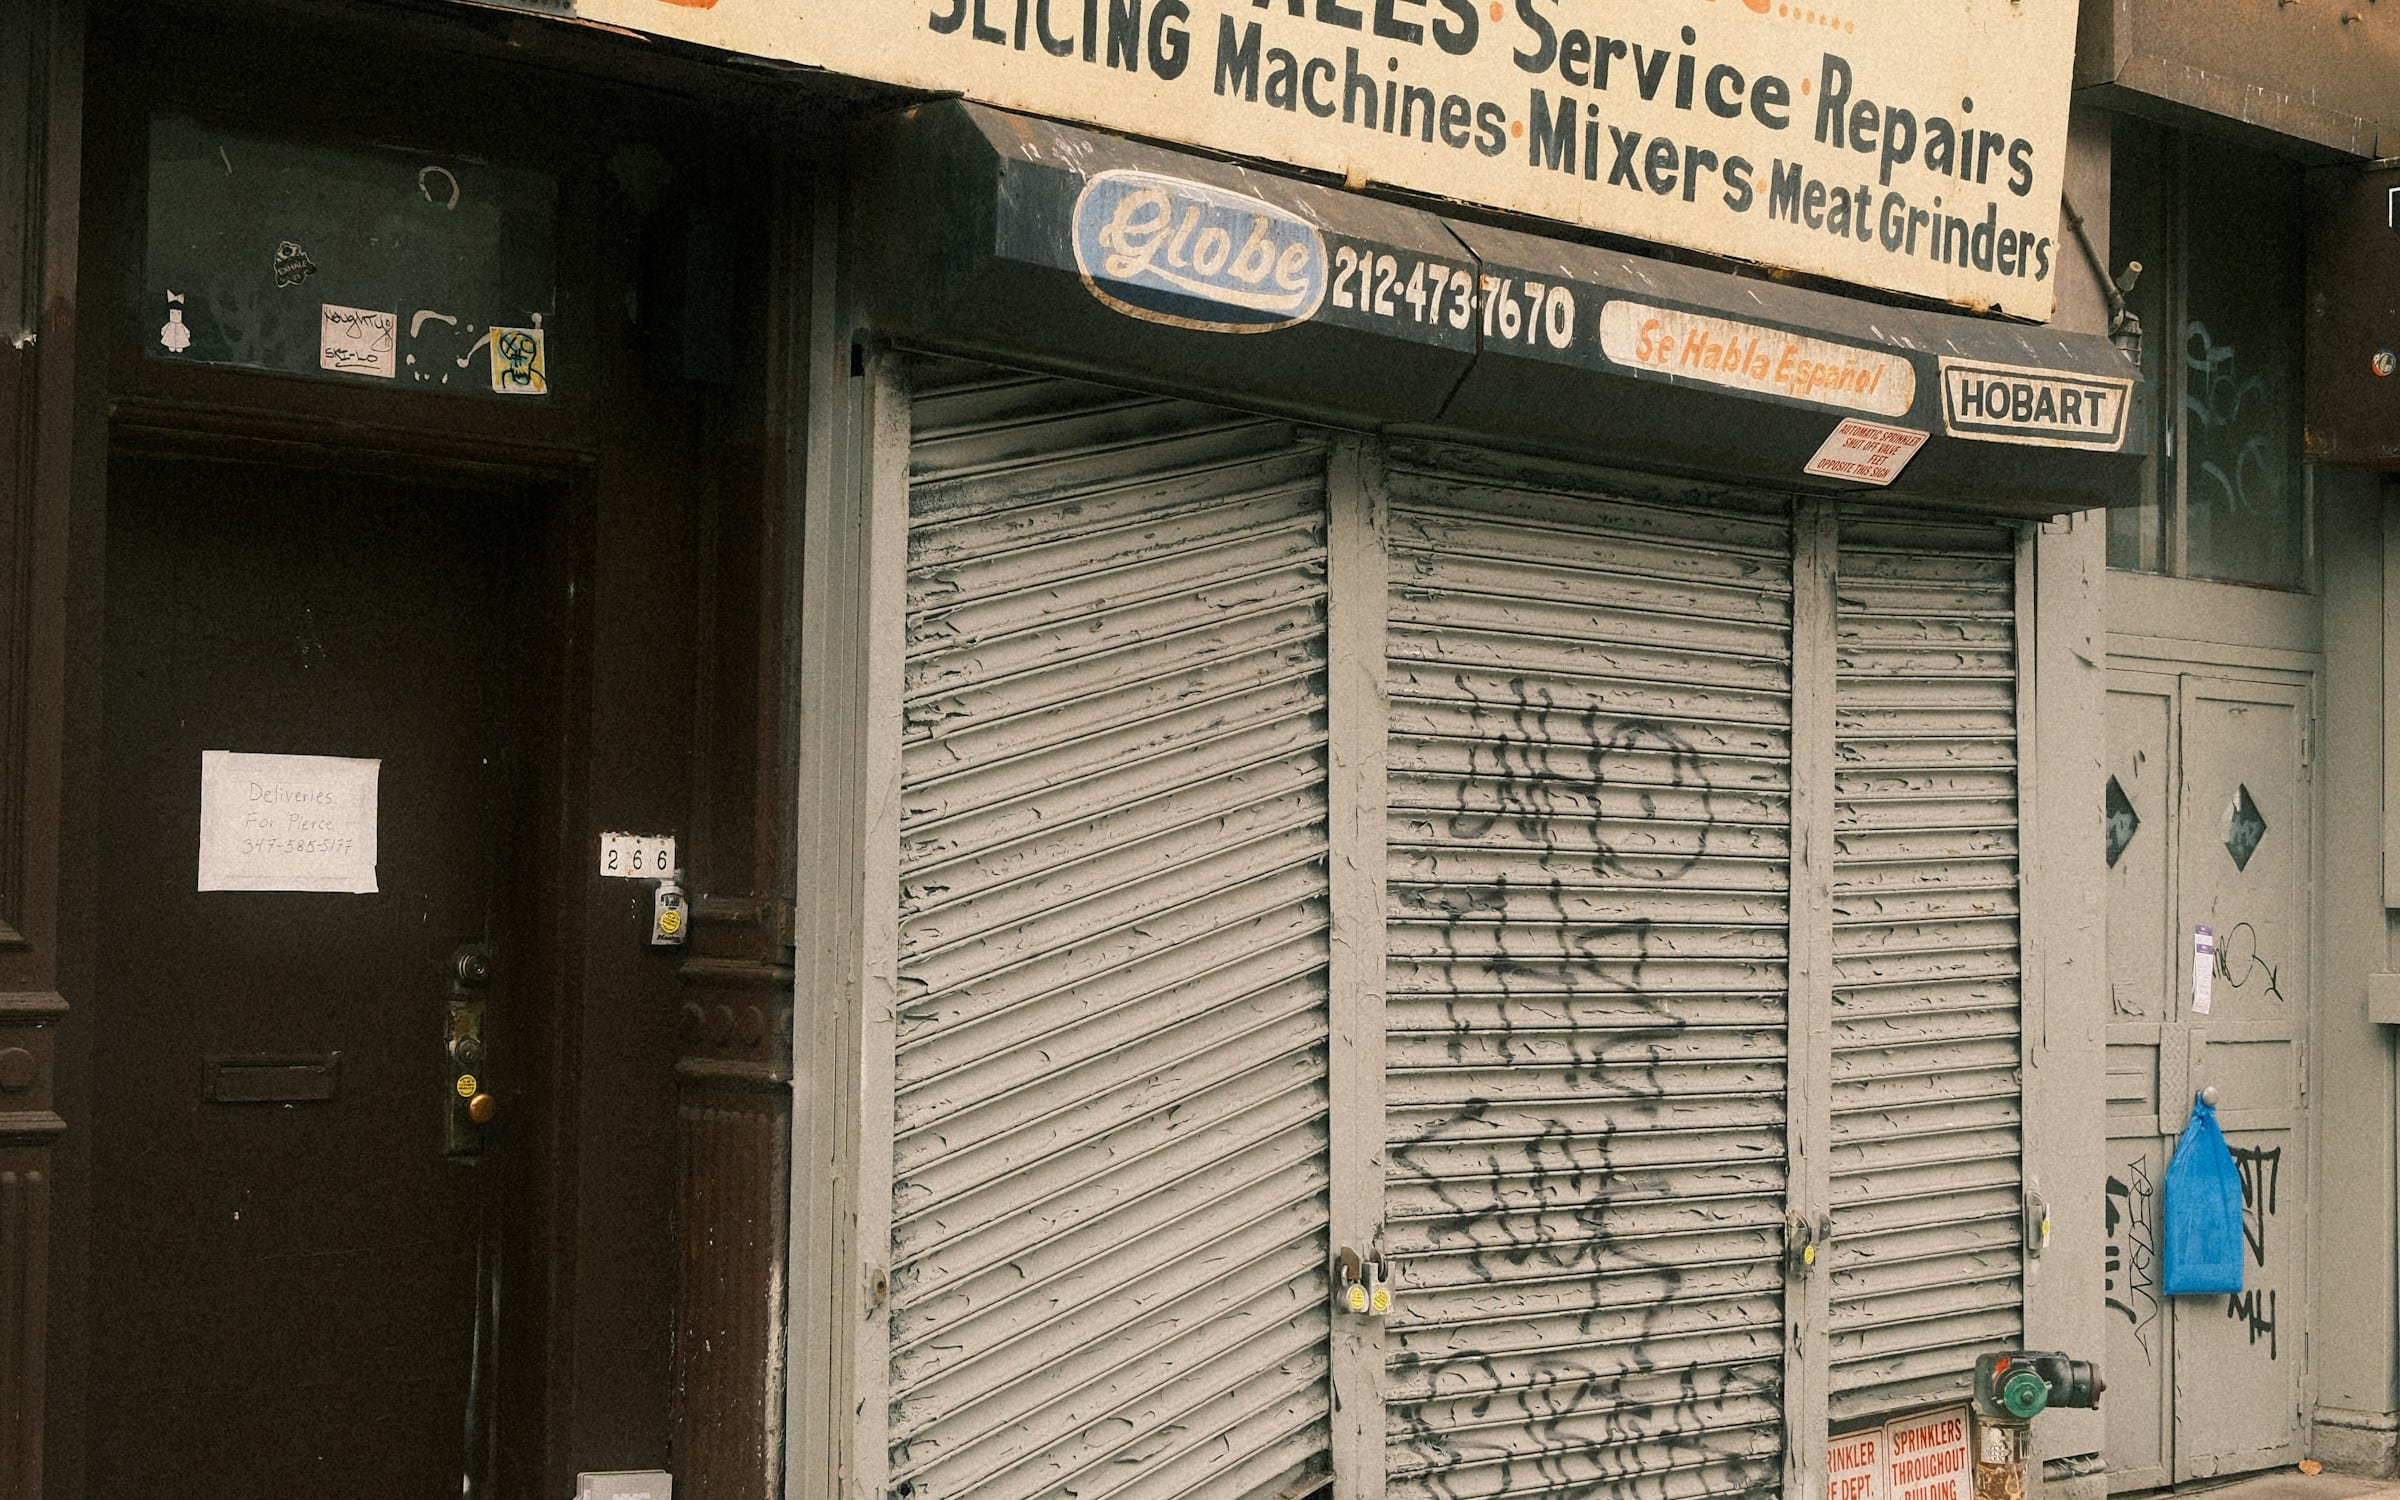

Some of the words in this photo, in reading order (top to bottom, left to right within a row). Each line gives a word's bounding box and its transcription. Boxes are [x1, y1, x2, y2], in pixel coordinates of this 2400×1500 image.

[1513, 0, 1790, 130] Service
[1814, 52, 2034, 197] Repairs
[1213, 13, 1506, 157] Machines
[1529, 88, 1754, 212] Mixers
[1769, 158, 1873, 242] Meat
[1879, 192, 2053, 282] Grinders
[1101, 187, 1310, 304] Globe
[1635, 318, 1674, 364] Se
[1680, 328, 1771, 381] Habla
[1775, 343, 1885, 394] Español
[1961, 379, 2106, 427] HOBART
[1839, 424, 1882, 440] AUTOMATIC
[1880, 431, 1921, 447] SPRINKLER
[1843, 438, 1863, 449] SHUT
[1863, 440, 1879, 452] OFF
[1878, 443, 1901, 456] VALVE
[1817, 458, 1855, 473] OPPOSITE
[1854, 464, 1872, 476] THIS
[1870, 467, 1890, 479] SIGN
[1867, 454, 1888, 465] FEET
[250, 782, 332, 804] Deliveries
[244, 812, 276, 830] For
[288, 813, 334, 831] Pierce
[608, 850, 667, 870] 266
[1893, 1418, 1961, 1456] SPRINKLERS
[1891, 1447, 1965, 1487] THROUGHOUT
